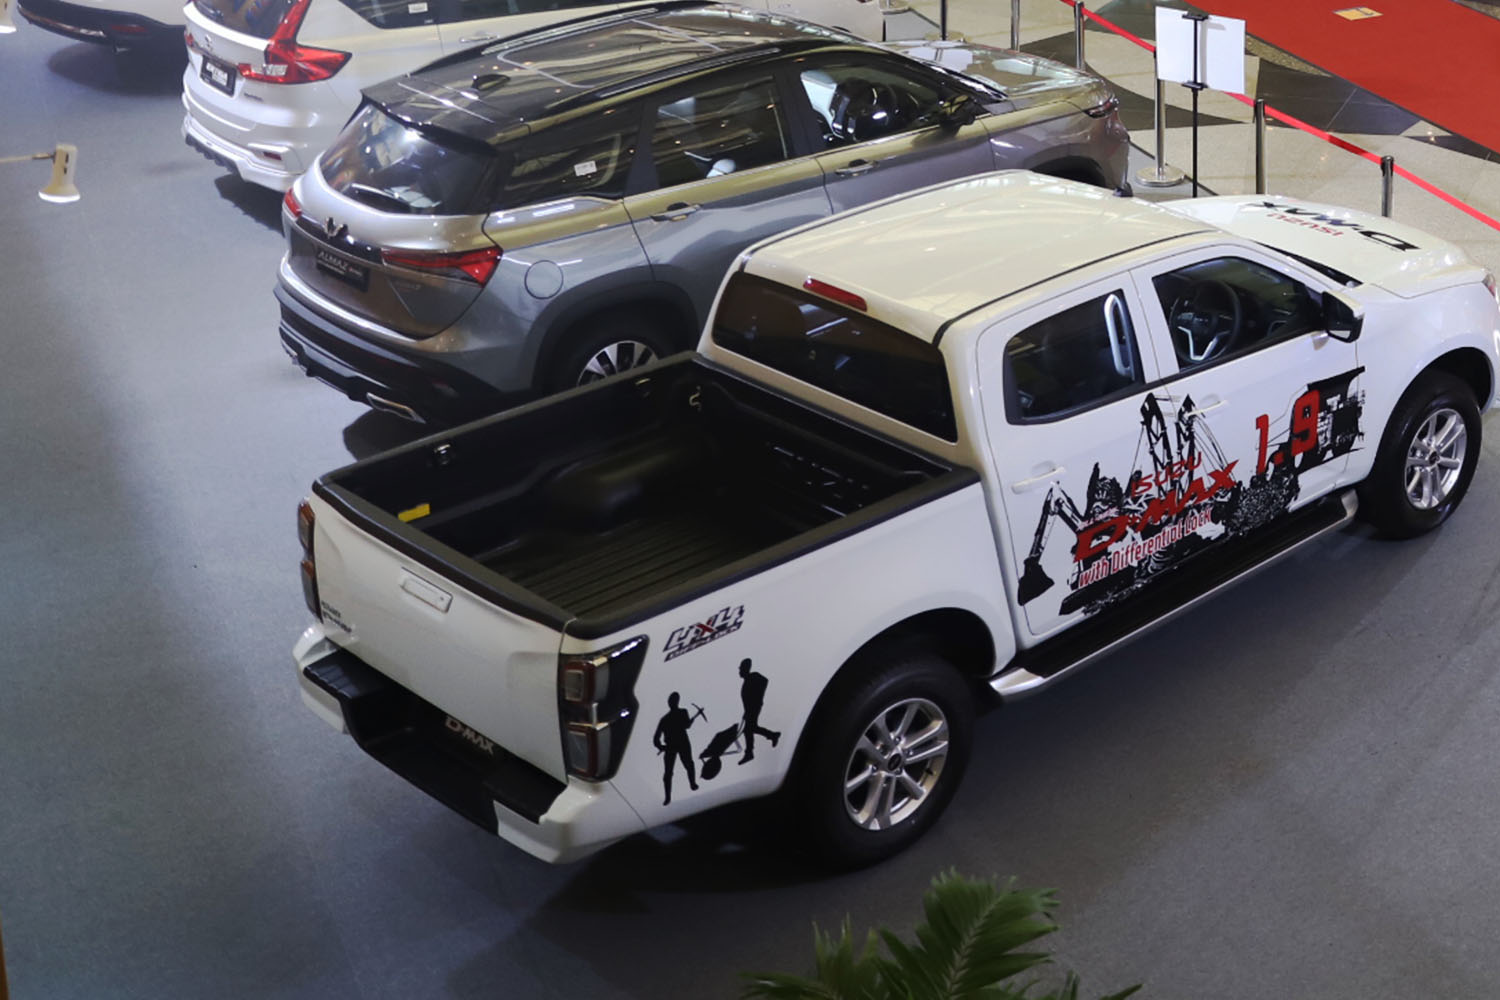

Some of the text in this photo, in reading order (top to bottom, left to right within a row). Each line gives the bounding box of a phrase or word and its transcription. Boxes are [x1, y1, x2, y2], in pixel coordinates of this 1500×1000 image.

[318, 251, 348, 270] ALMAZ
[1255, 389, 1320, 476] 1.9
[1131, 452, 1202, 497] ISUZU
[1073, 459, 1240, 563] D-MAX
[1079, 556, 1110, 588] with
[1110, 518, 1183, 575] Differential
